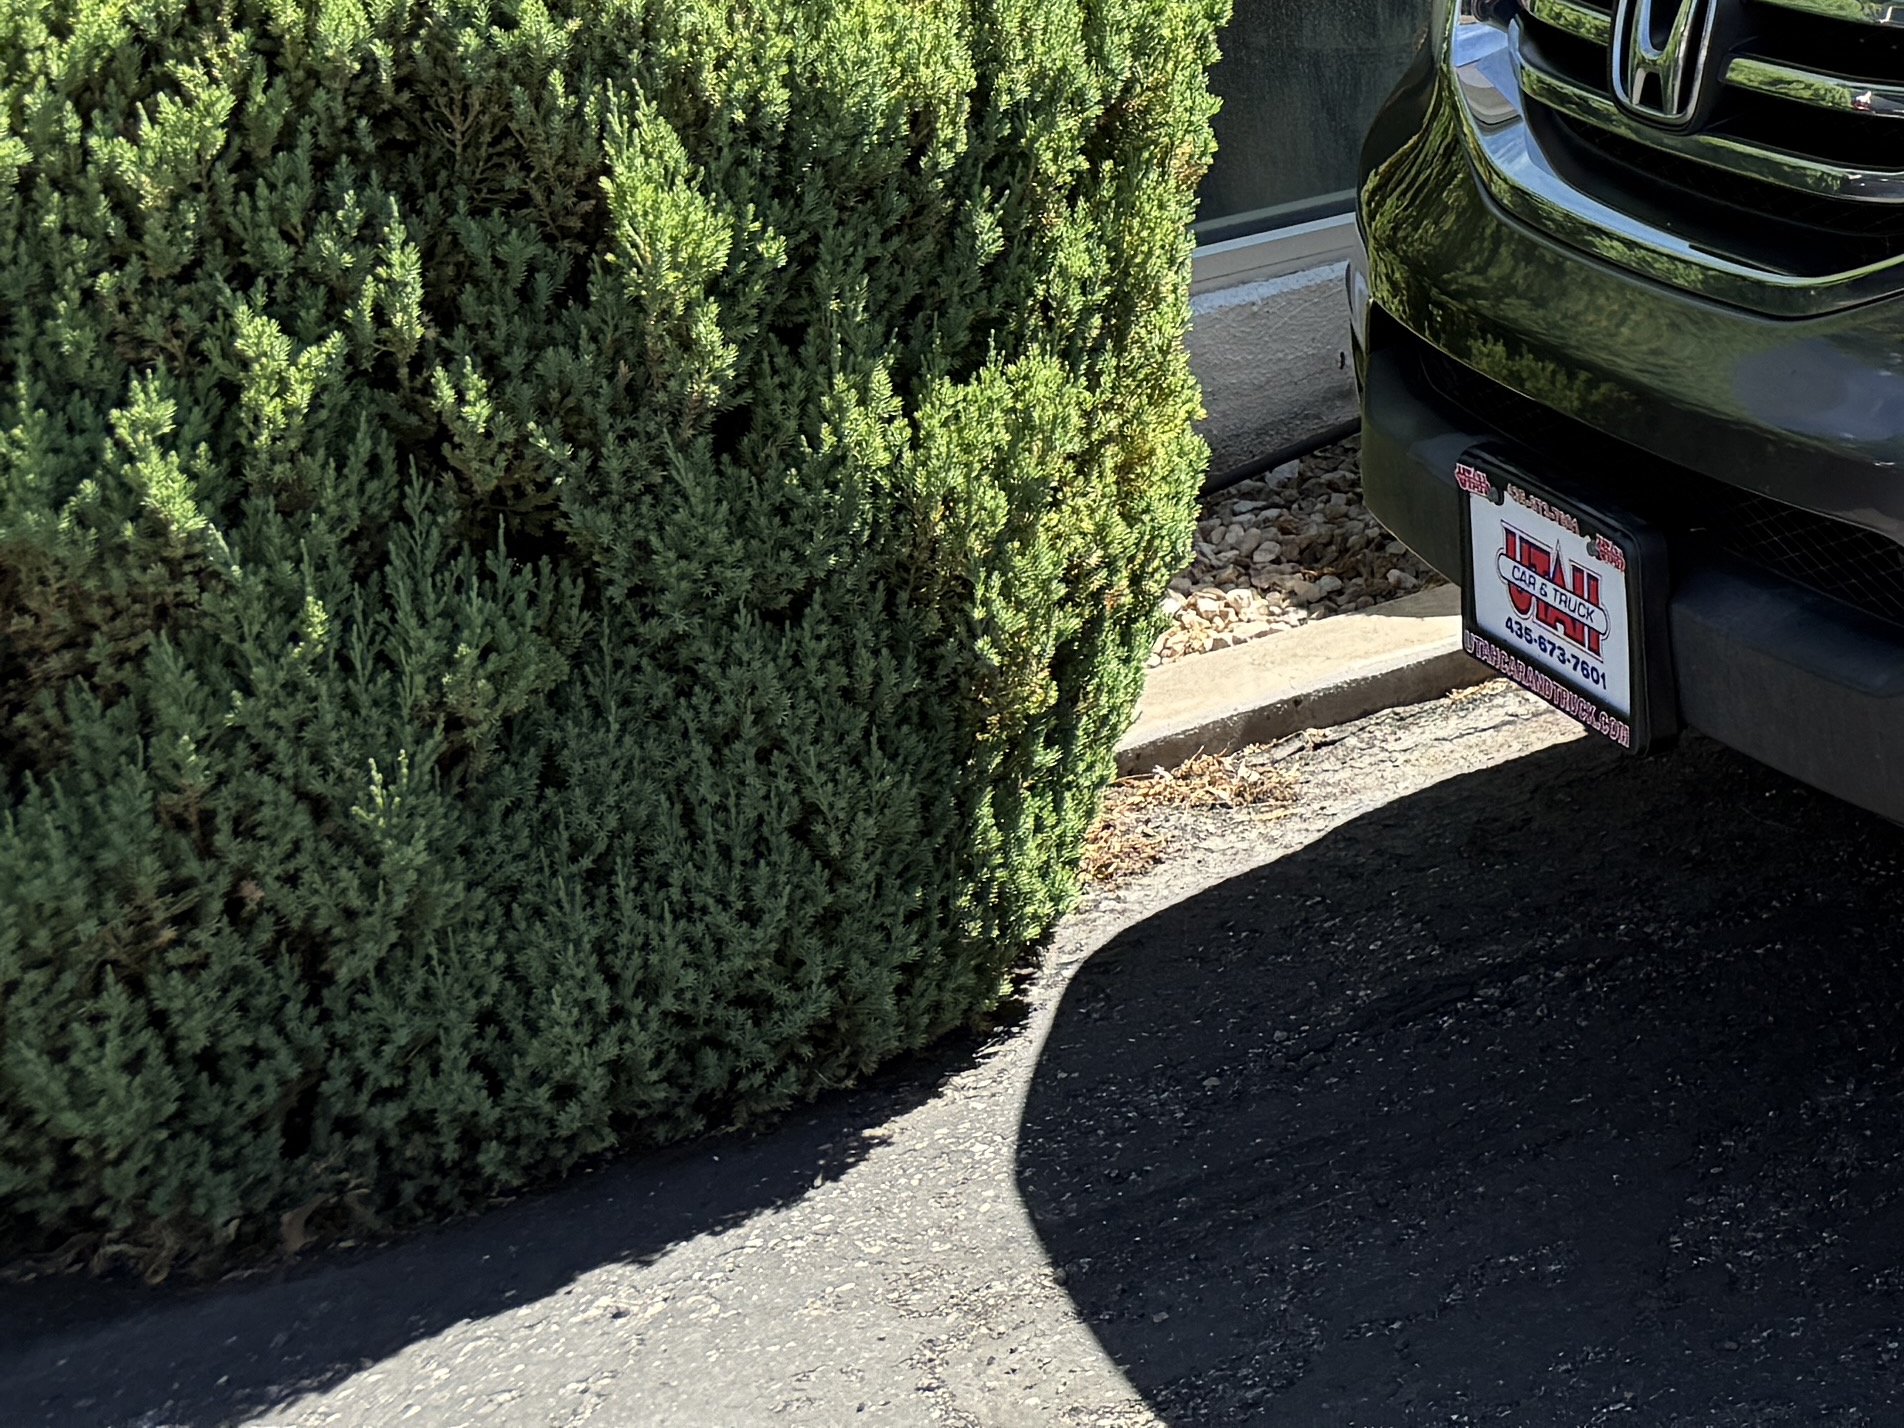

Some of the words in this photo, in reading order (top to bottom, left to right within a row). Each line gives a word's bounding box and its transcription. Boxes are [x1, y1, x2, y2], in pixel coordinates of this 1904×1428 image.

[1502, 524, 1602, 658] UTAH
[1511, 565, 1536, 591] CAR
[1552, 587, 1595, 623] TRUCK
[1505, 616, 1607, 690] 435-673-7601
